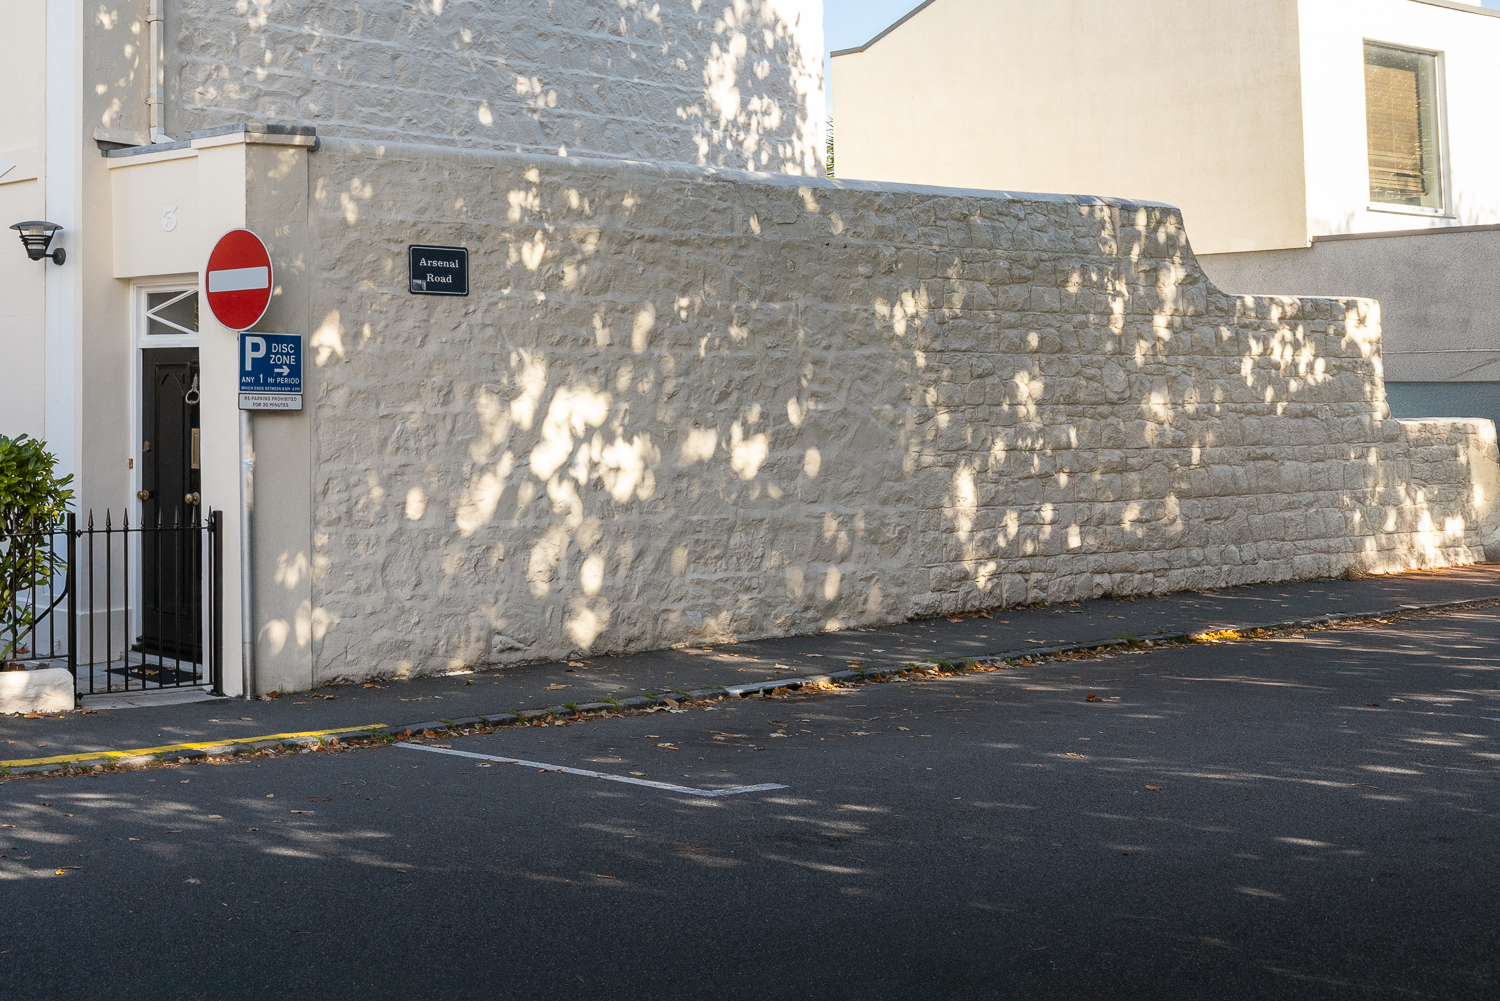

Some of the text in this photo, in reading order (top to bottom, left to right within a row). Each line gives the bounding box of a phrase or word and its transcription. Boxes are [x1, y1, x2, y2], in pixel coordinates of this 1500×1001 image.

[162, 205, 177, 232] 3
[419, 257, 459, 268] Arsenal
[426, 273, 452, 283] Road
[245, 336, 267, 371] P
[272, 343, 295, 353] DISC
[270, 354, 296, 365] ZONE
[259, 373, 263, 384] 1
